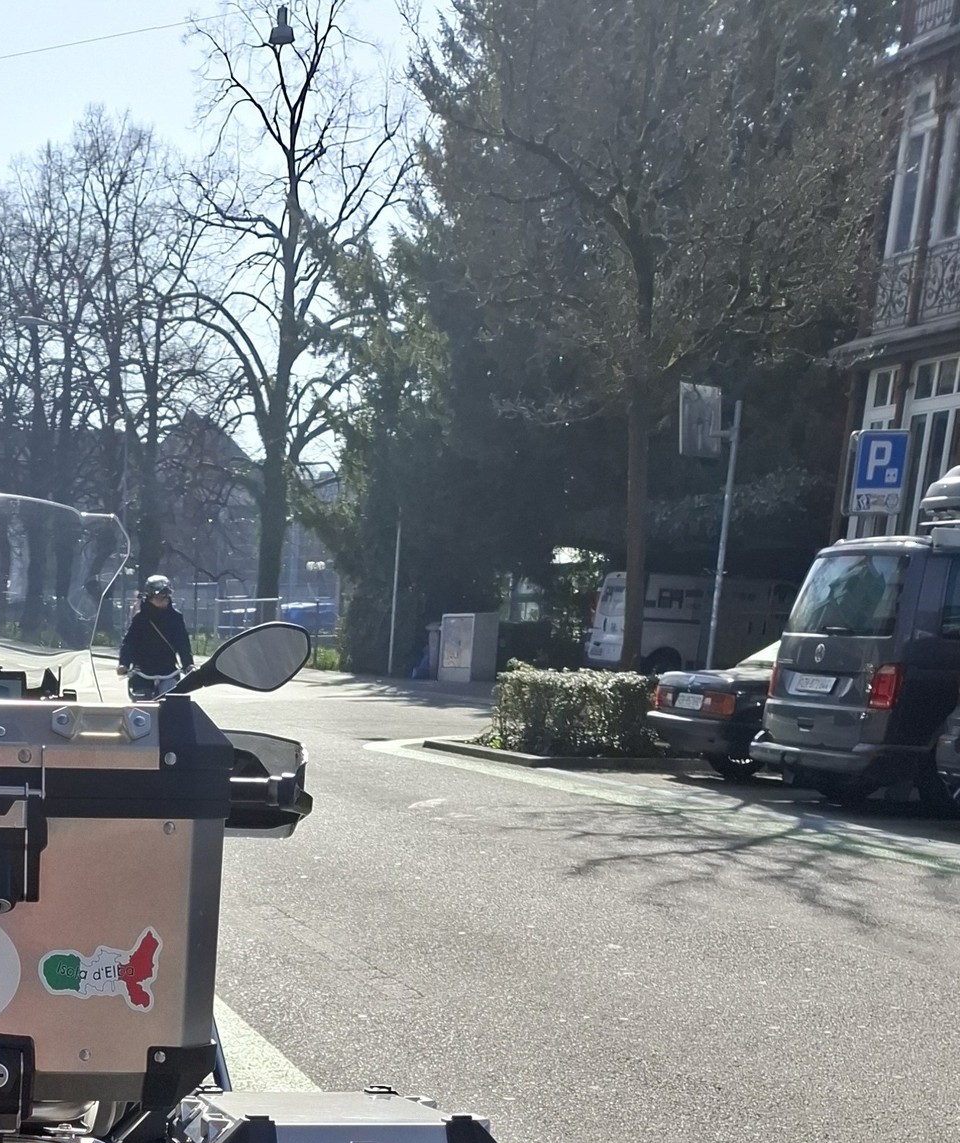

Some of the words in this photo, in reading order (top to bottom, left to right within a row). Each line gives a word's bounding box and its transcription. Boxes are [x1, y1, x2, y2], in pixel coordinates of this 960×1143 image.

[866, 440, 893, 480] P
[56, 962, 88, 980] Isola
[92, 963, 135, 981] d'Elba
